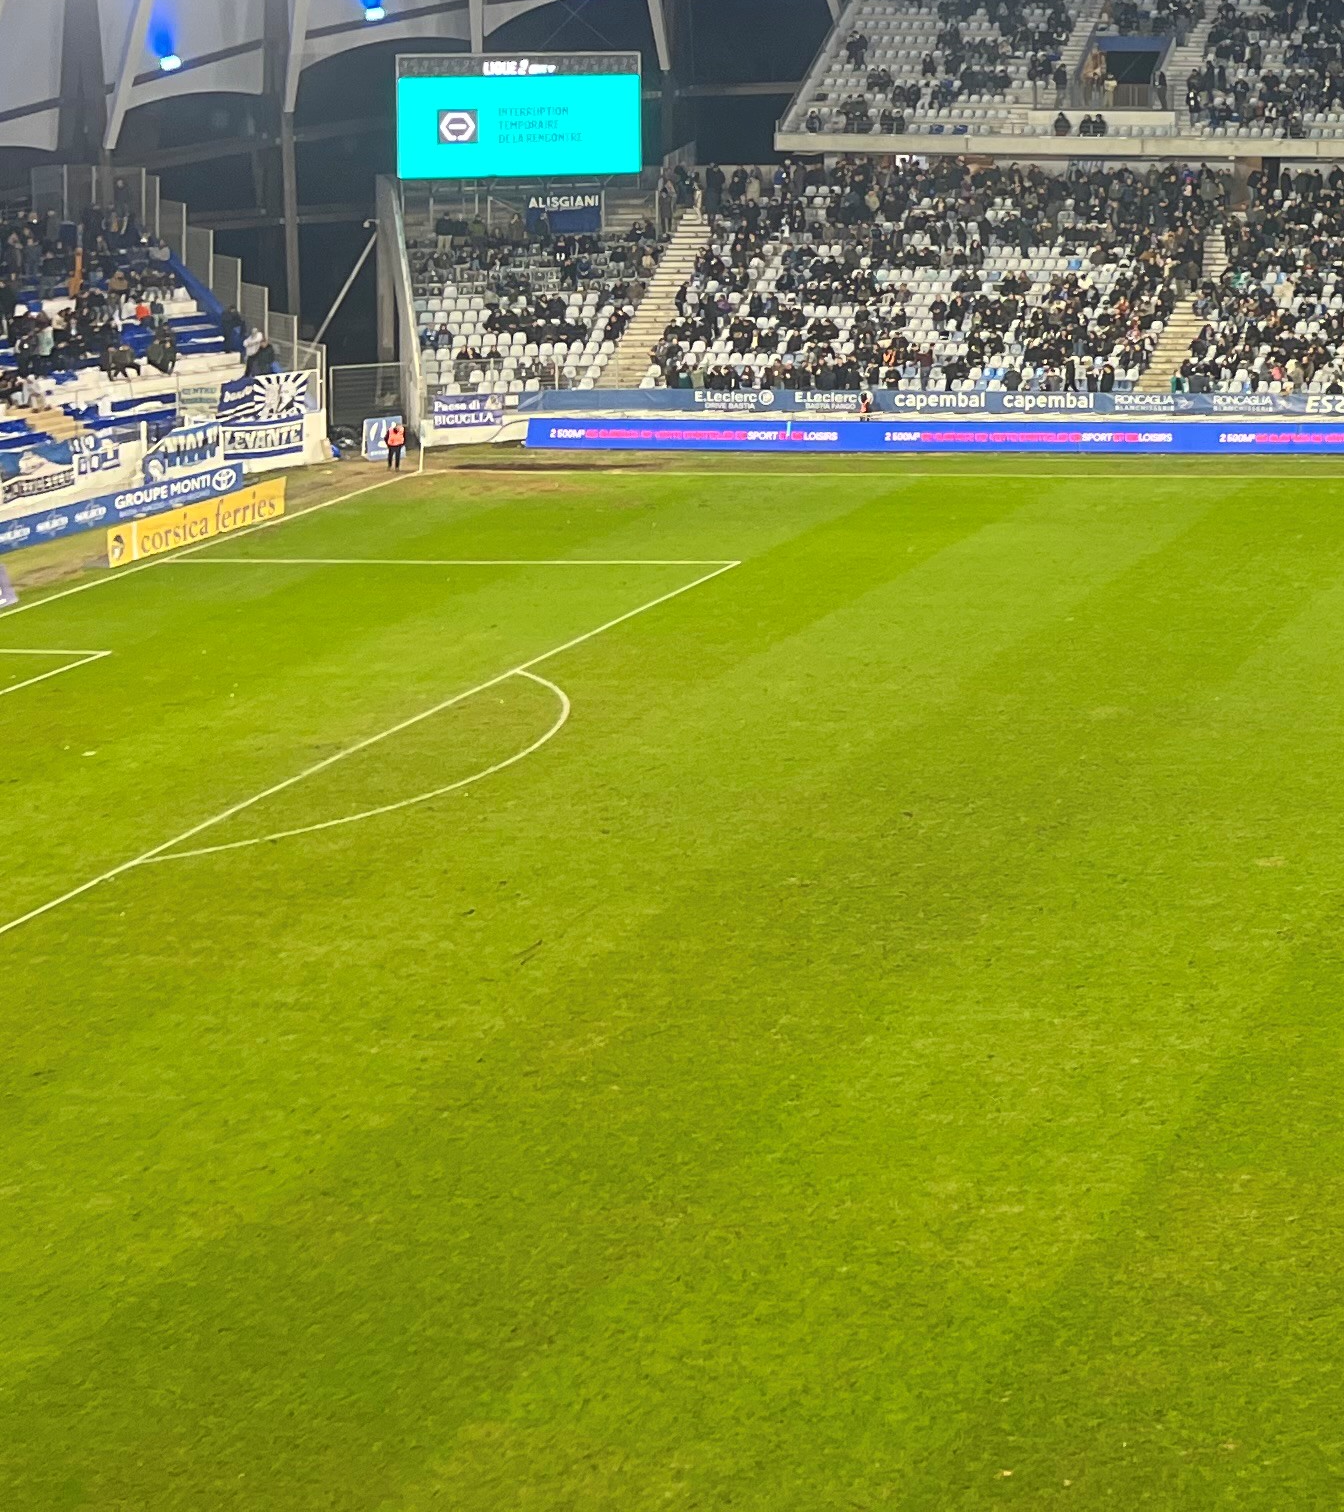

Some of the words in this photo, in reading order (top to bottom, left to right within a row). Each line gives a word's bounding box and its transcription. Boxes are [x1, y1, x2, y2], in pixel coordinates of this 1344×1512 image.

[498, 107, 569, 117] INTERRUPTION
[499, 120, 559, 130] TEMPORAIRE
[526, 132, 583, 143] RENCONTRE
[528, 194, 599, 208] ALISGIANI
[694, 390, 758, 403] E.Leclerc
[794, 391, 858, 403] E.Leclerc
[894, 391, 986, 411] capembal
[1002, 392, 1094, 411] capembal
[1114, 394, 1175, 405] RONCAGLIA
[1212, 395, 1274, 406] RONCAGLIA
[224, 421, 302, 452] LEVANTE
[747, 431, 779, 441] SPORT
[1081, 433, 1113, 442] SPORT
[1138, 433, 1173, 442] LOISIRS
[114, 485, 169, 510] GROUPE
[170, 474, 211, 496] MONTI
[140, 512, 209, 553] corsica
[215, 490, 276, 531] ferries
